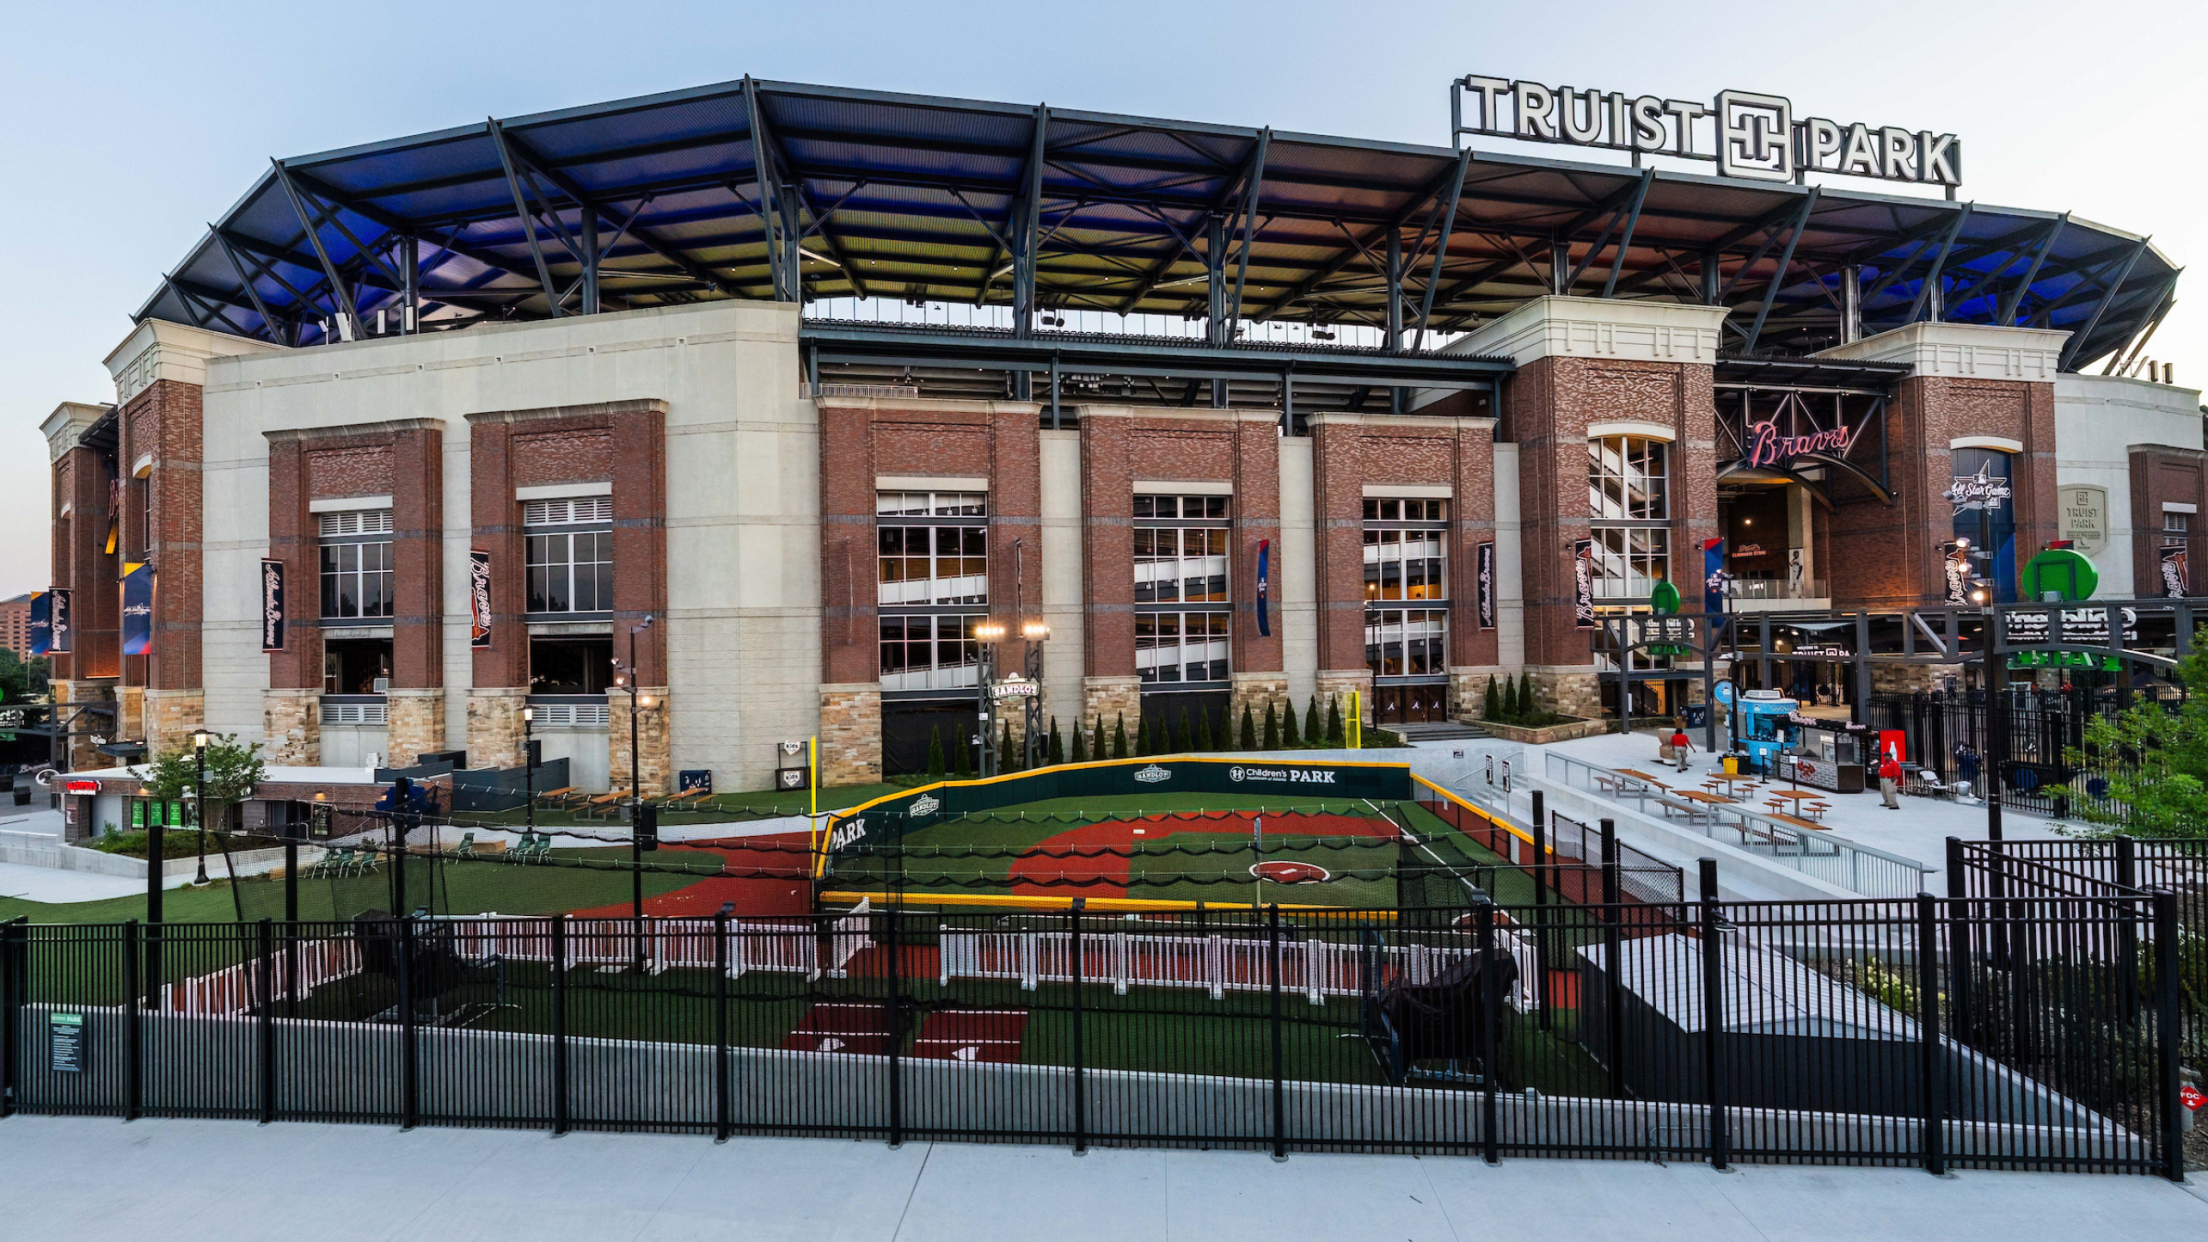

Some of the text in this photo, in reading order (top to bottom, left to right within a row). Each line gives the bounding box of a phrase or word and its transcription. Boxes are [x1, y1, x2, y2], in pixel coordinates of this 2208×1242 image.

[1466, 73, 1960, 186] TRUIST PARK
[1748, 420, 1850, 469] Braves
[1966, 483, 1984, 497] Star
[1985, 483, 2011, 499] Game
[2067, 507, 2098, 517] TRUIST
[2071, 519, 2095, 529] PARK
[471, 556, 491, 627] Braves
[1576, 559, 1594, 622] Braves
[265, 563, 281, 648] Atlanta Braves
[994, 684, 1037, 697] SANDLOT
[1246, 768, 1287, 778] Children's
[1290, 769, 1336, 783] PARK
[2180, 1090, 2200, 1099] FDC
